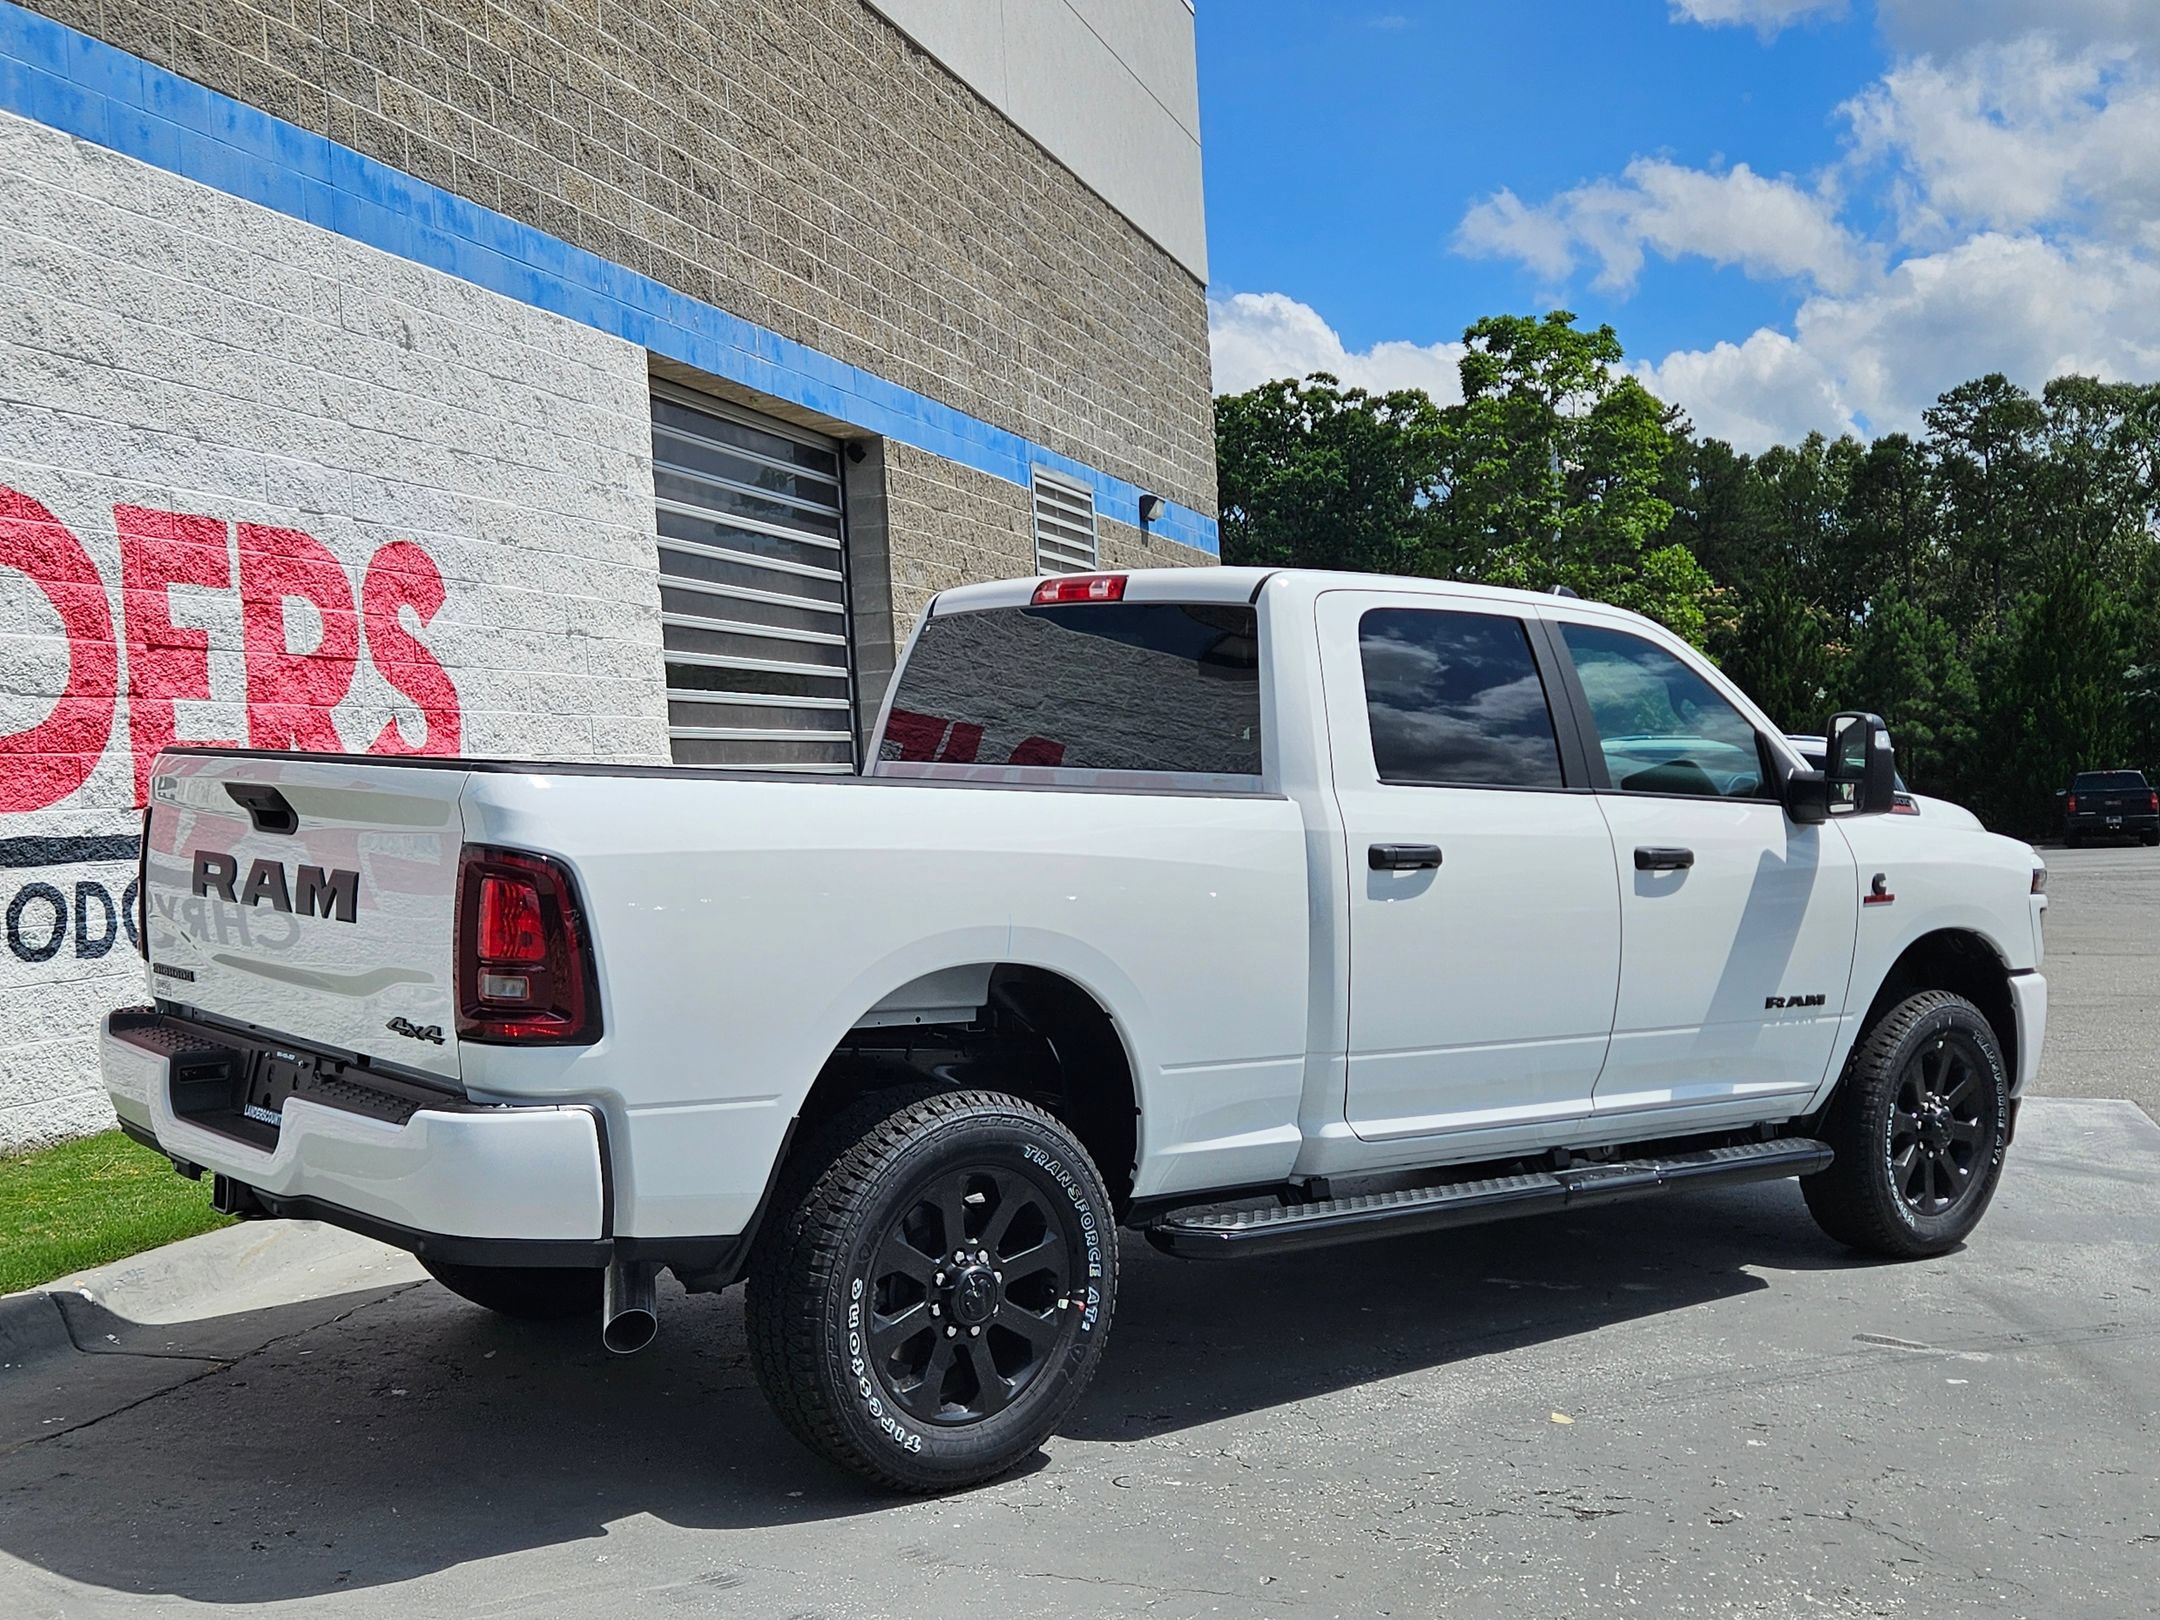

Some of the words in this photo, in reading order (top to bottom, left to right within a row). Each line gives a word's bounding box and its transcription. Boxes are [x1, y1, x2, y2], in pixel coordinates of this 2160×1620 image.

[192, 850, 360, 924] RAM
[386, 1016, 447, 1045] 4x4
[1765, 994, 1826, 1009] RAM
[1025, 1144, 1102, 1278] TRANSFORCE
[848, 1277, 922, 1454] Firestone
